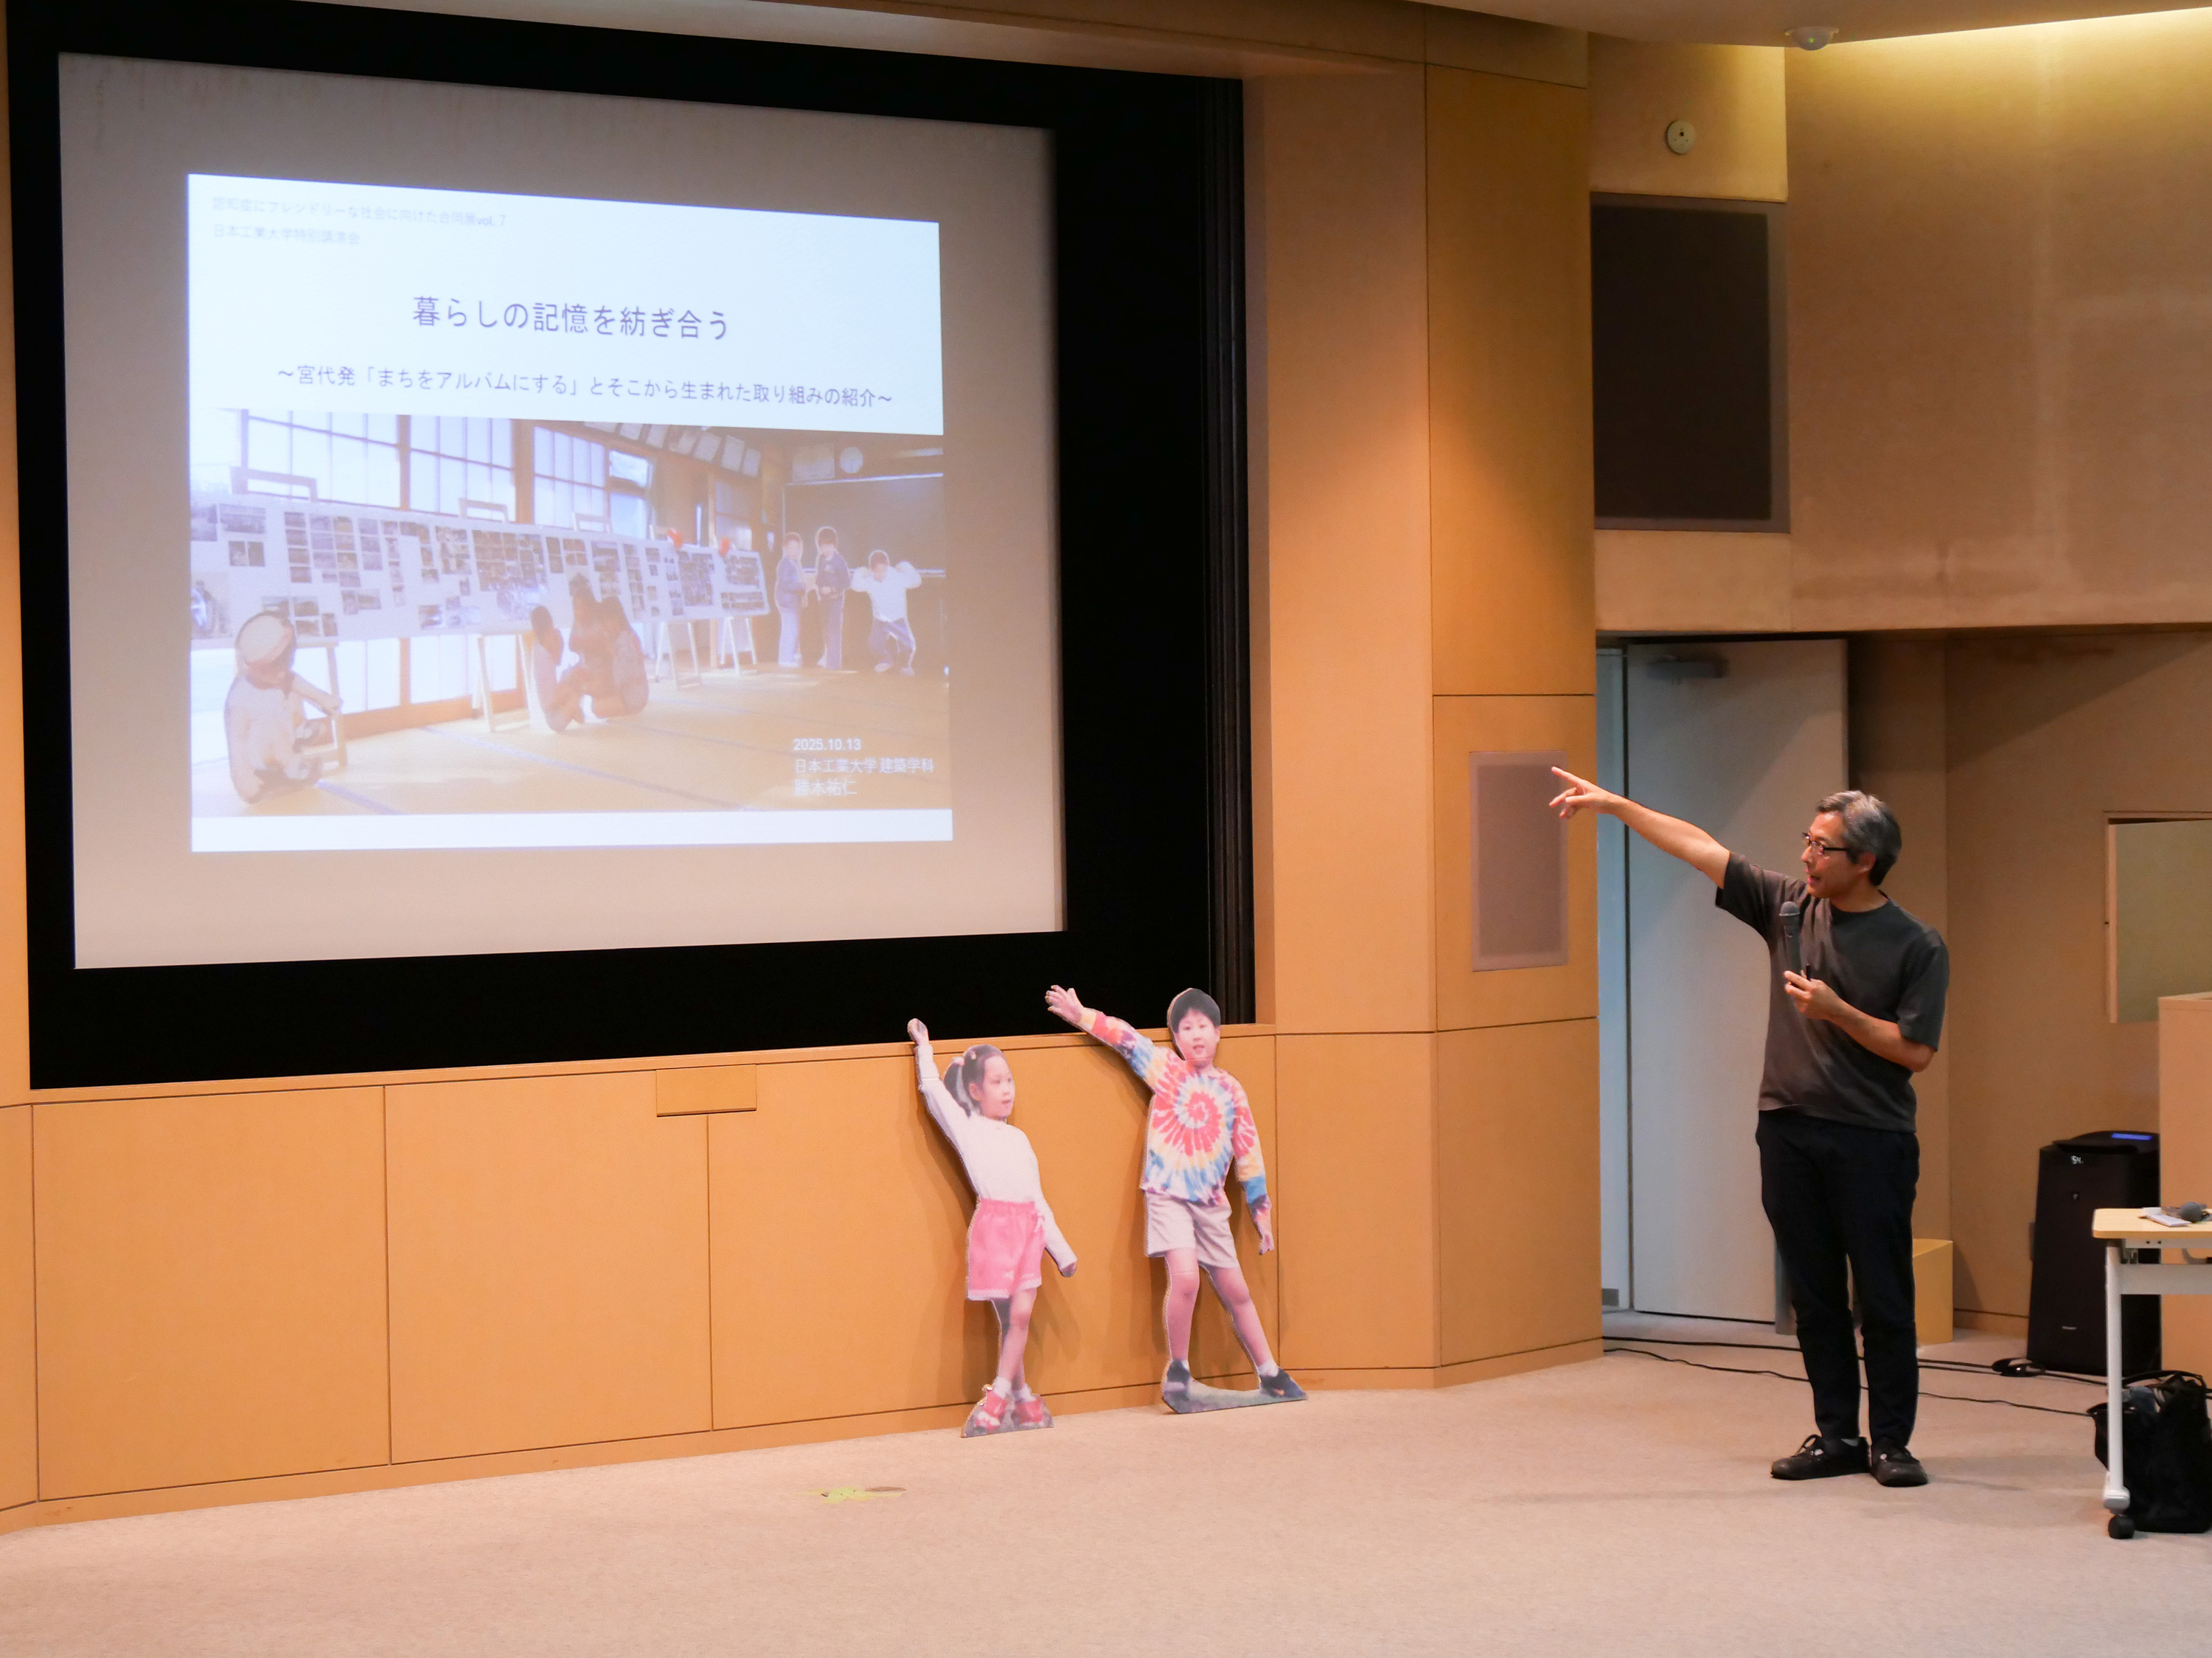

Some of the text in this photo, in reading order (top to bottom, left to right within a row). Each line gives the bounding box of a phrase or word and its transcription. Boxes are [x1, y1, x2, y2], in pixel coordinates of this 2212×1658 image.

[413, 295, 727, 340] 暮らしの記憶を紡ぎ合う
[793, 738, 862, 751] 2025.10.13
